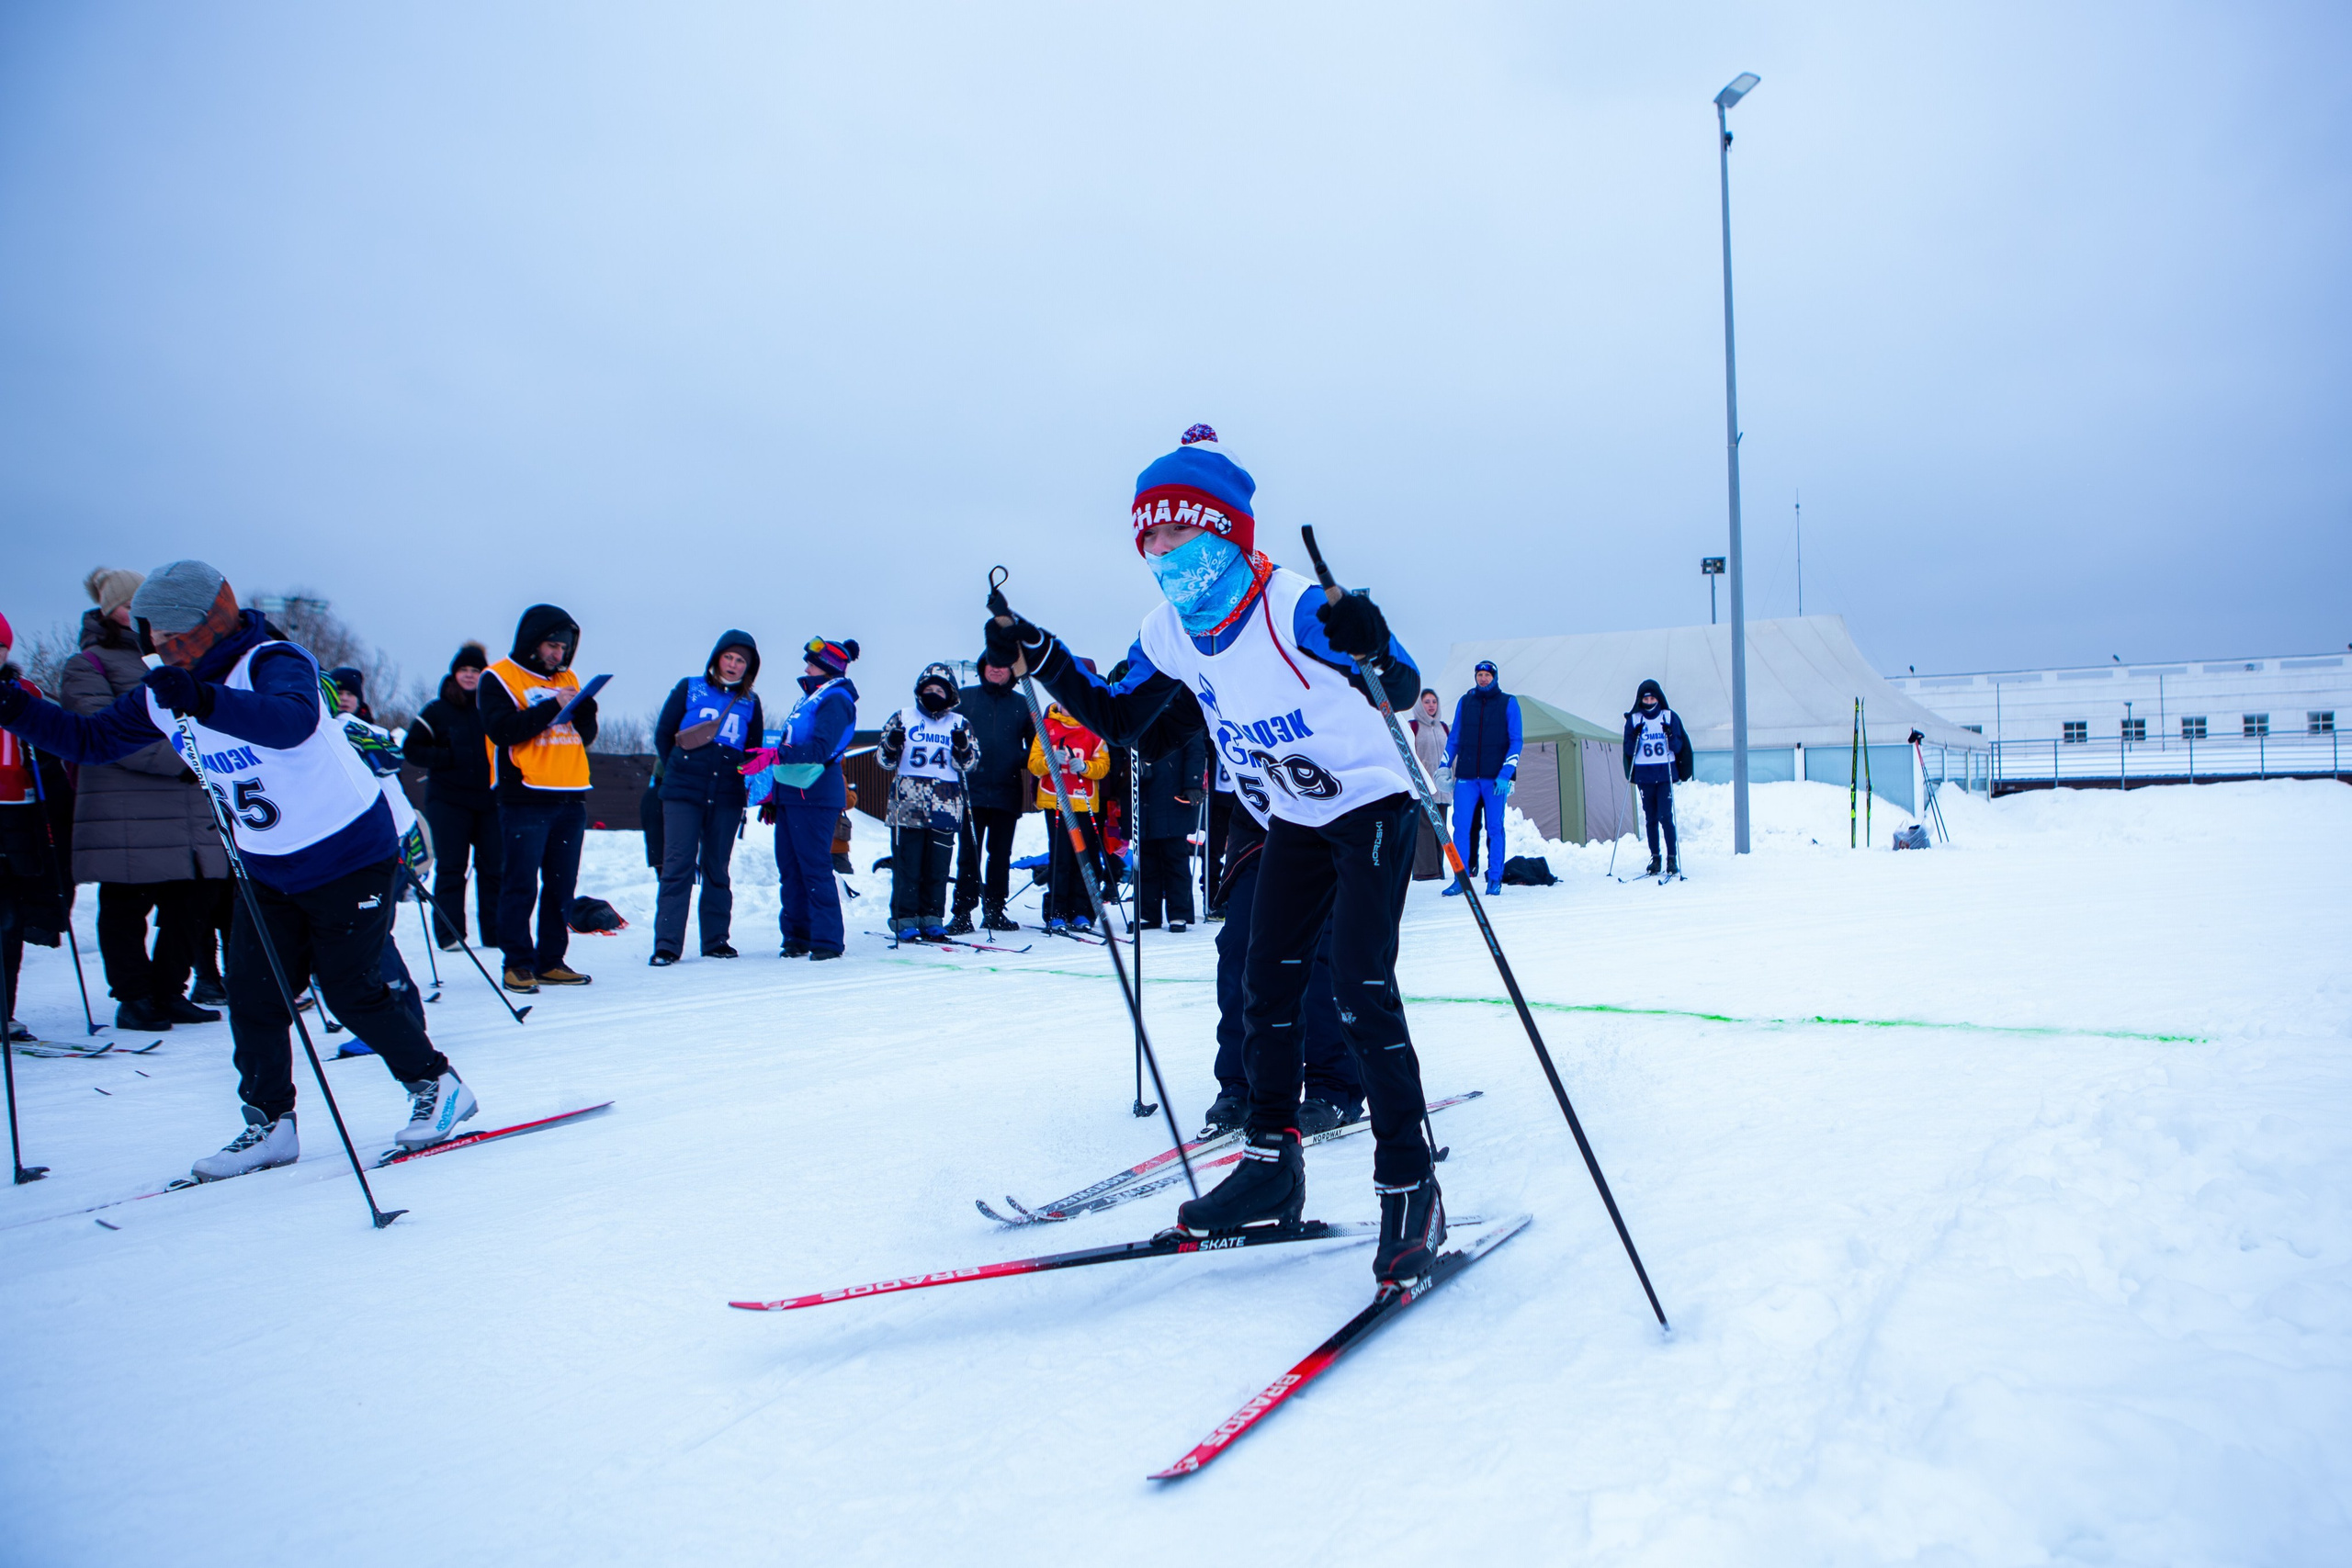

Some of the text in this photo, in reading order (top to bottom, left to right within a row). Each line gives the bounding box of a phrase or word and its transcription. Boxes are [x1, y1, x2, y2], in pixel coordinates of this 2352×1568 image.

[910, 746, 947, 769] 54
[1644, 742, 1665, 757] 66
[1131, 750, 1139, 856] MADSHUS
[1372, 820, 1383, 866] NORDSKI
[1312, 1129, 1343, 1144] NORDWAY
[1199, 1235, 1246, 1251] SKATE
[820, 1266, 980, 1302] BRADOS
[1410, 1275, 1433, 1301] SKATE
[1202, 1373, 1302, 1448] BRADOS
